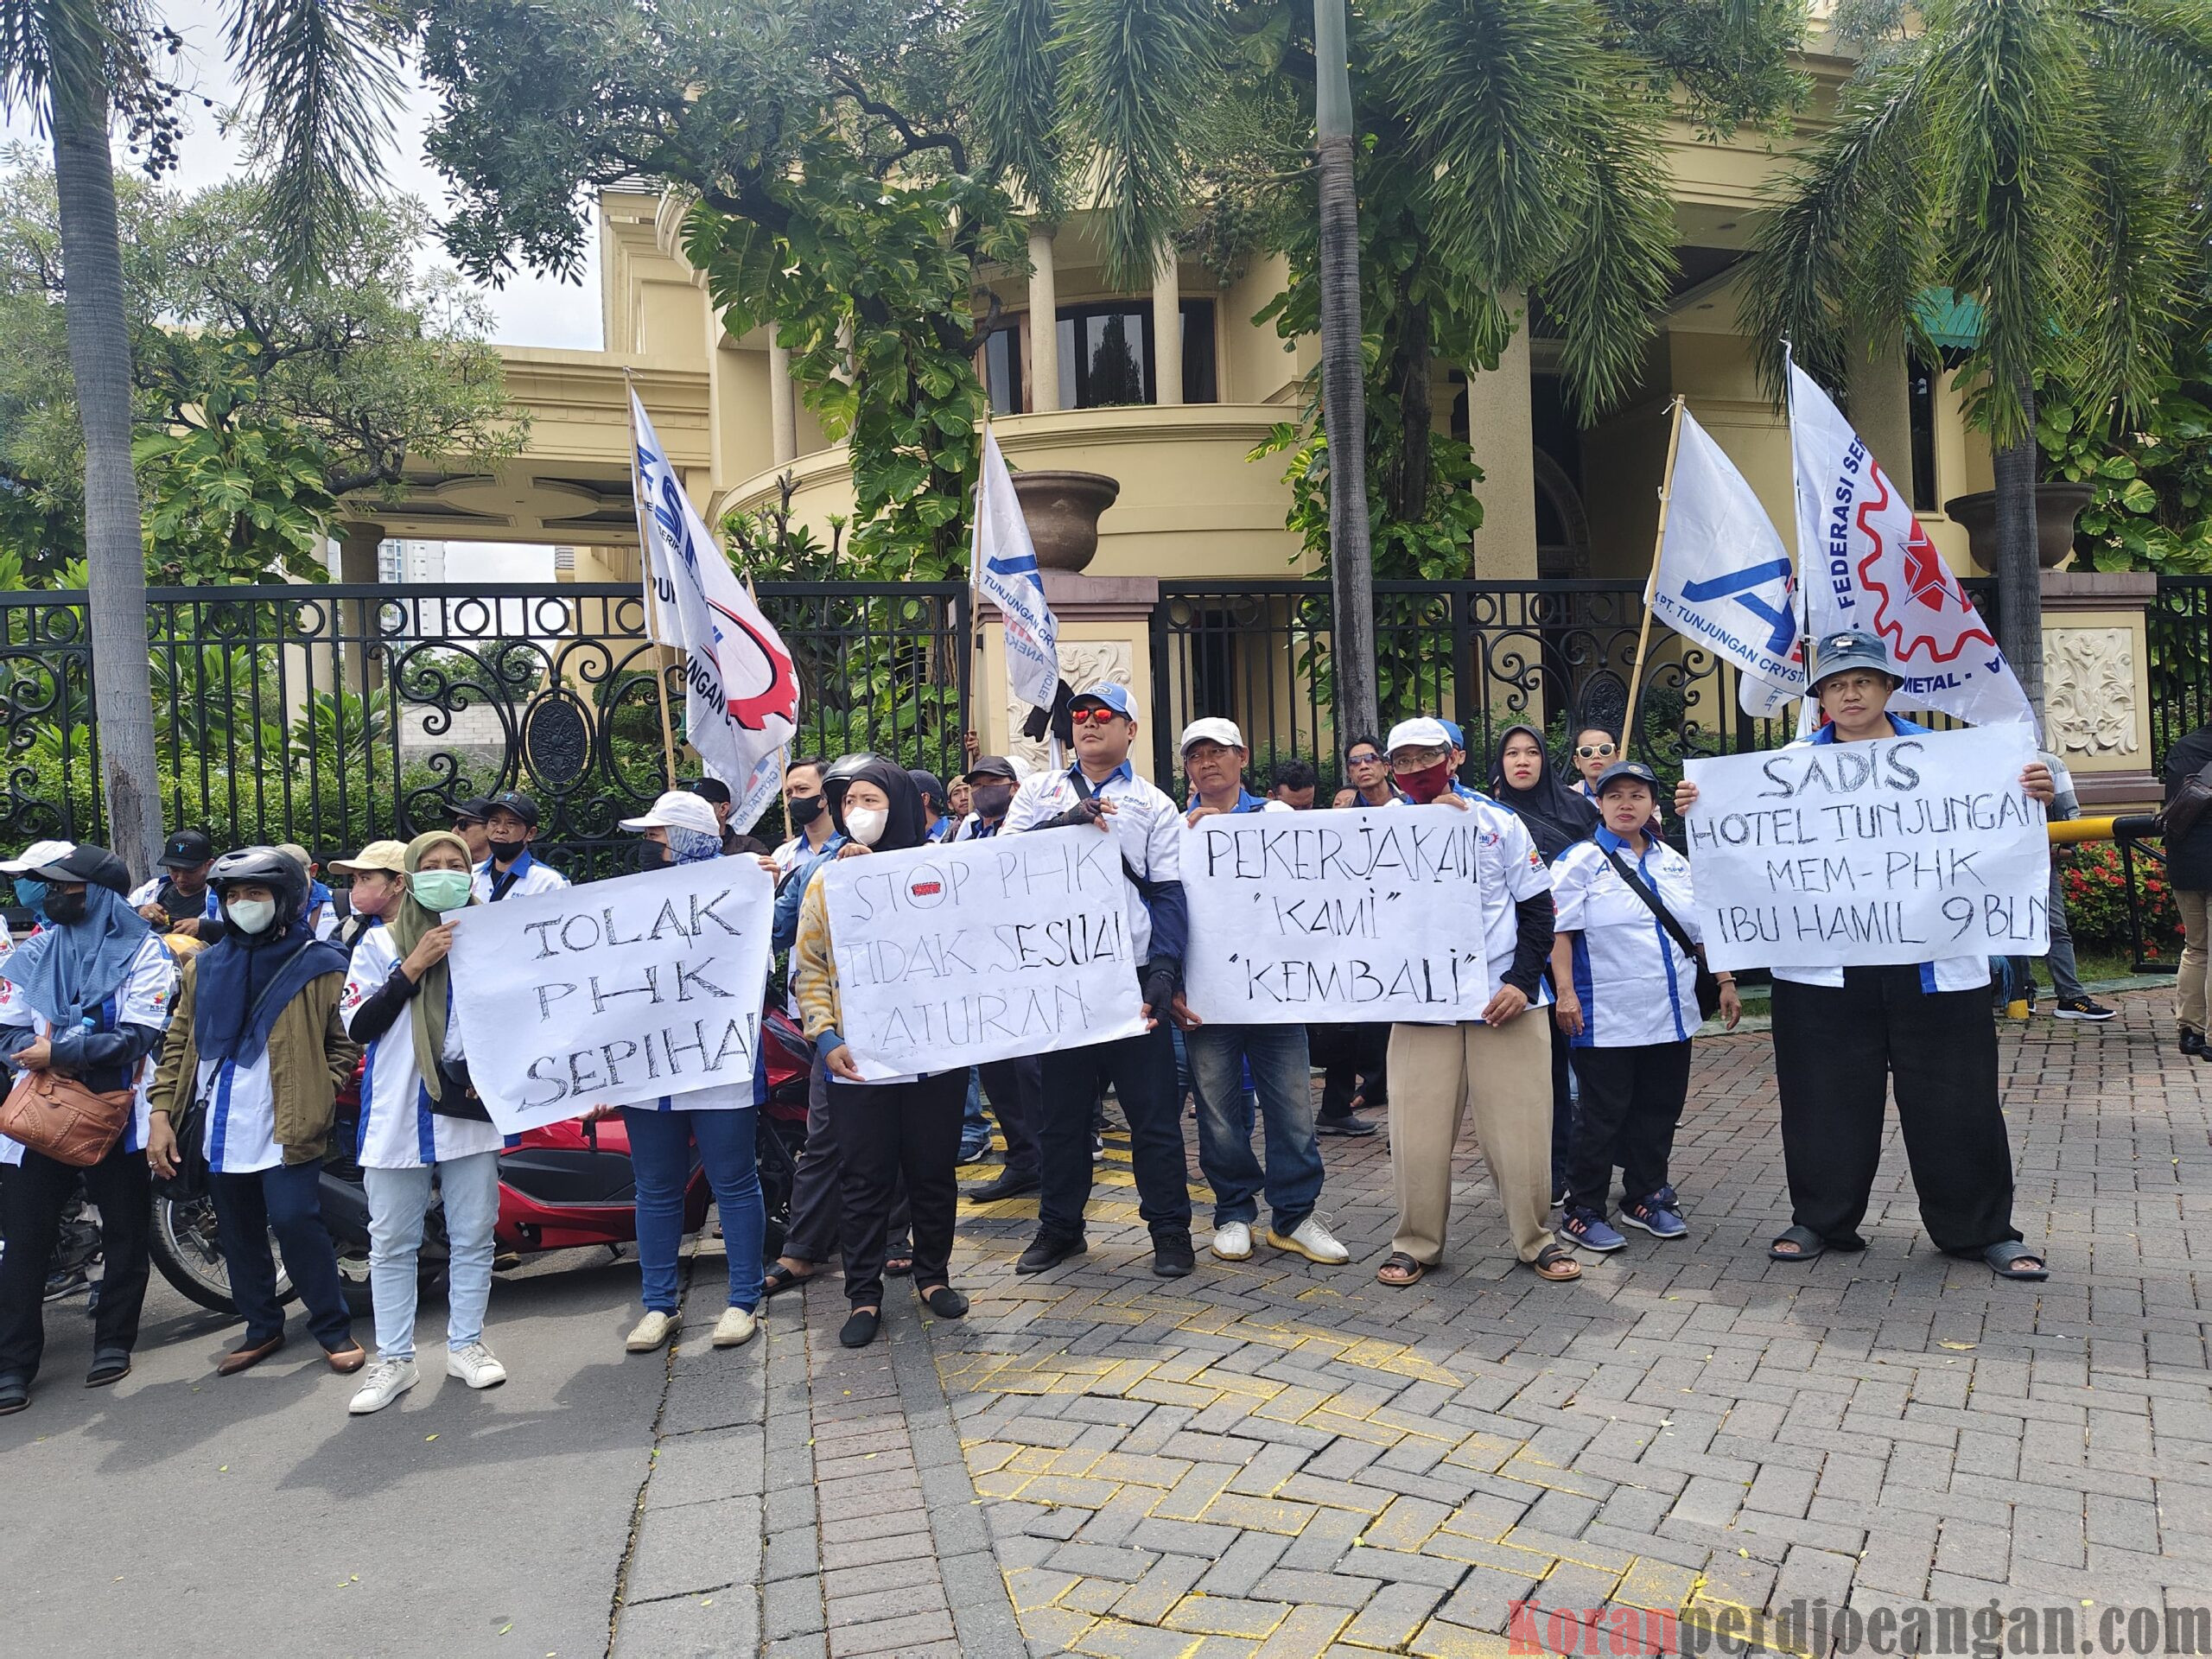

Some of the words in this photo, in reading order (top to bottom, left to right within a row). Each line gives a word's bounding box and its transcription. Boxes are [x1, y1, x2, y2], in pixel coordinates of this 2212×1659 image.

[1829, 477, 1856, 609] FEDERASI
[983, 575, 1039, 630] TUNJUNGAN
[1676, 606, 1758, 663] TUNJUNGAN
[1758, 741, 1924, 799] SADIS
[1205, 816, 1478, 884] PEKERJAKAN
[1690, 809, 1818, 850] HOTEL
[1821, 791, 2044, 843] TUNJUNGAN
[851, 861, 969, 921] STOP
[996, 839, 1113, 899] PHK
[524, 882, 741, 961] TOLAK
[838, 928, 977, 988] TIDAK
[988, 911, 1124, 974] SESUAI
[1718, 905, 1780, 944] IBU
[1793, 899, 1928, 945] HAMIL
[1942, 896, 1974, 942] 9
[1984, 893, 2049, 942] BLN
[533, 957, 735, 1023] PHK
[882, 979, 1089, 1051] ATURAN
